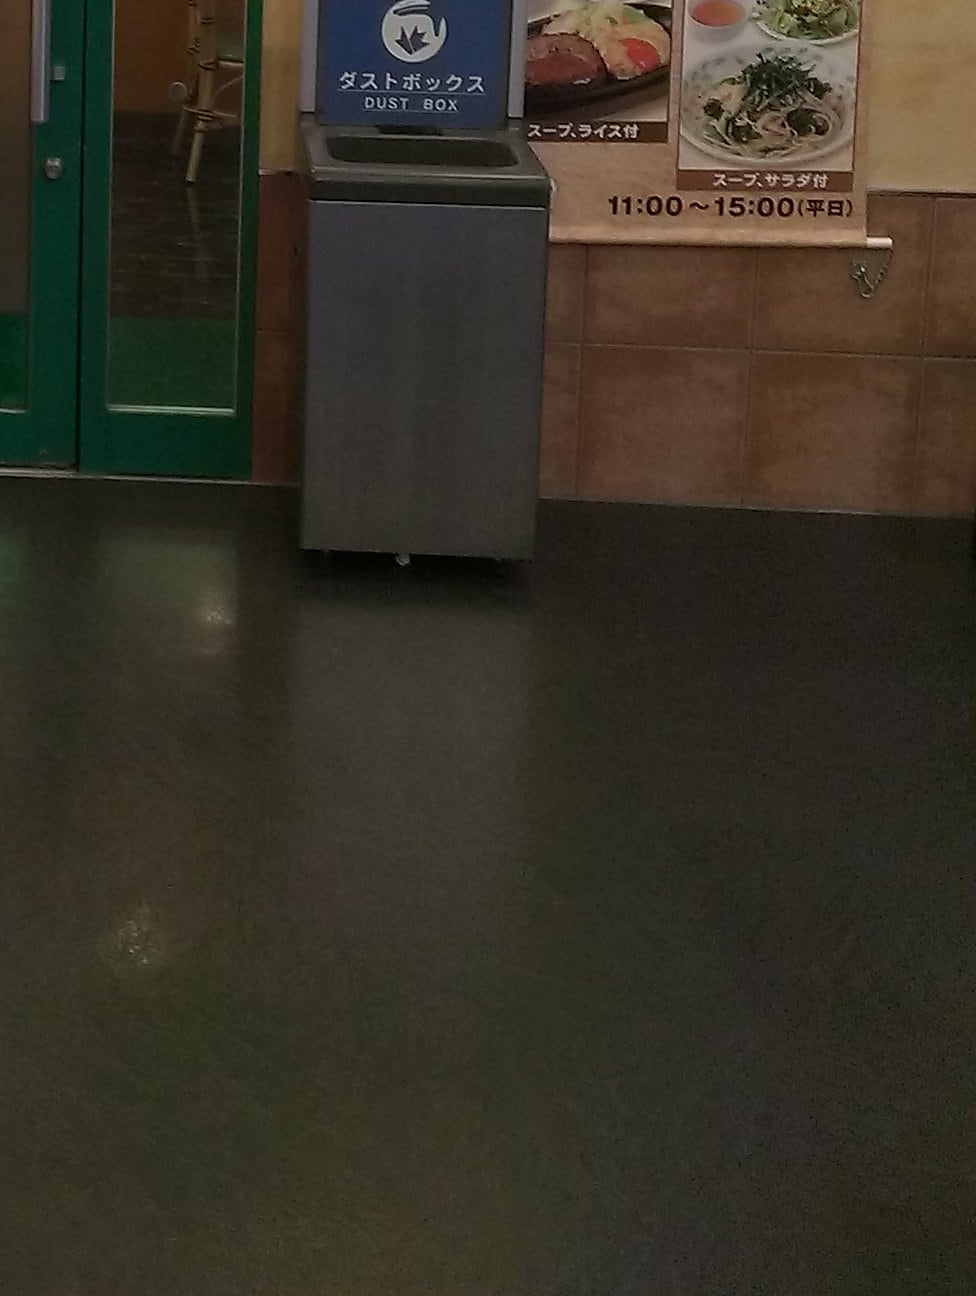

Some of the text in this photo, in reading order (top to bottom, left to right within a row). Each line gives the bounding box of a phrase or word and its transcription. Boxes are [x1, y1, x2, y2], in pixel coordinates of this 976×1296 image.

[339, 70, 485, 93] ダストボックス
[364, 96, 459, 111] DUST BOX
